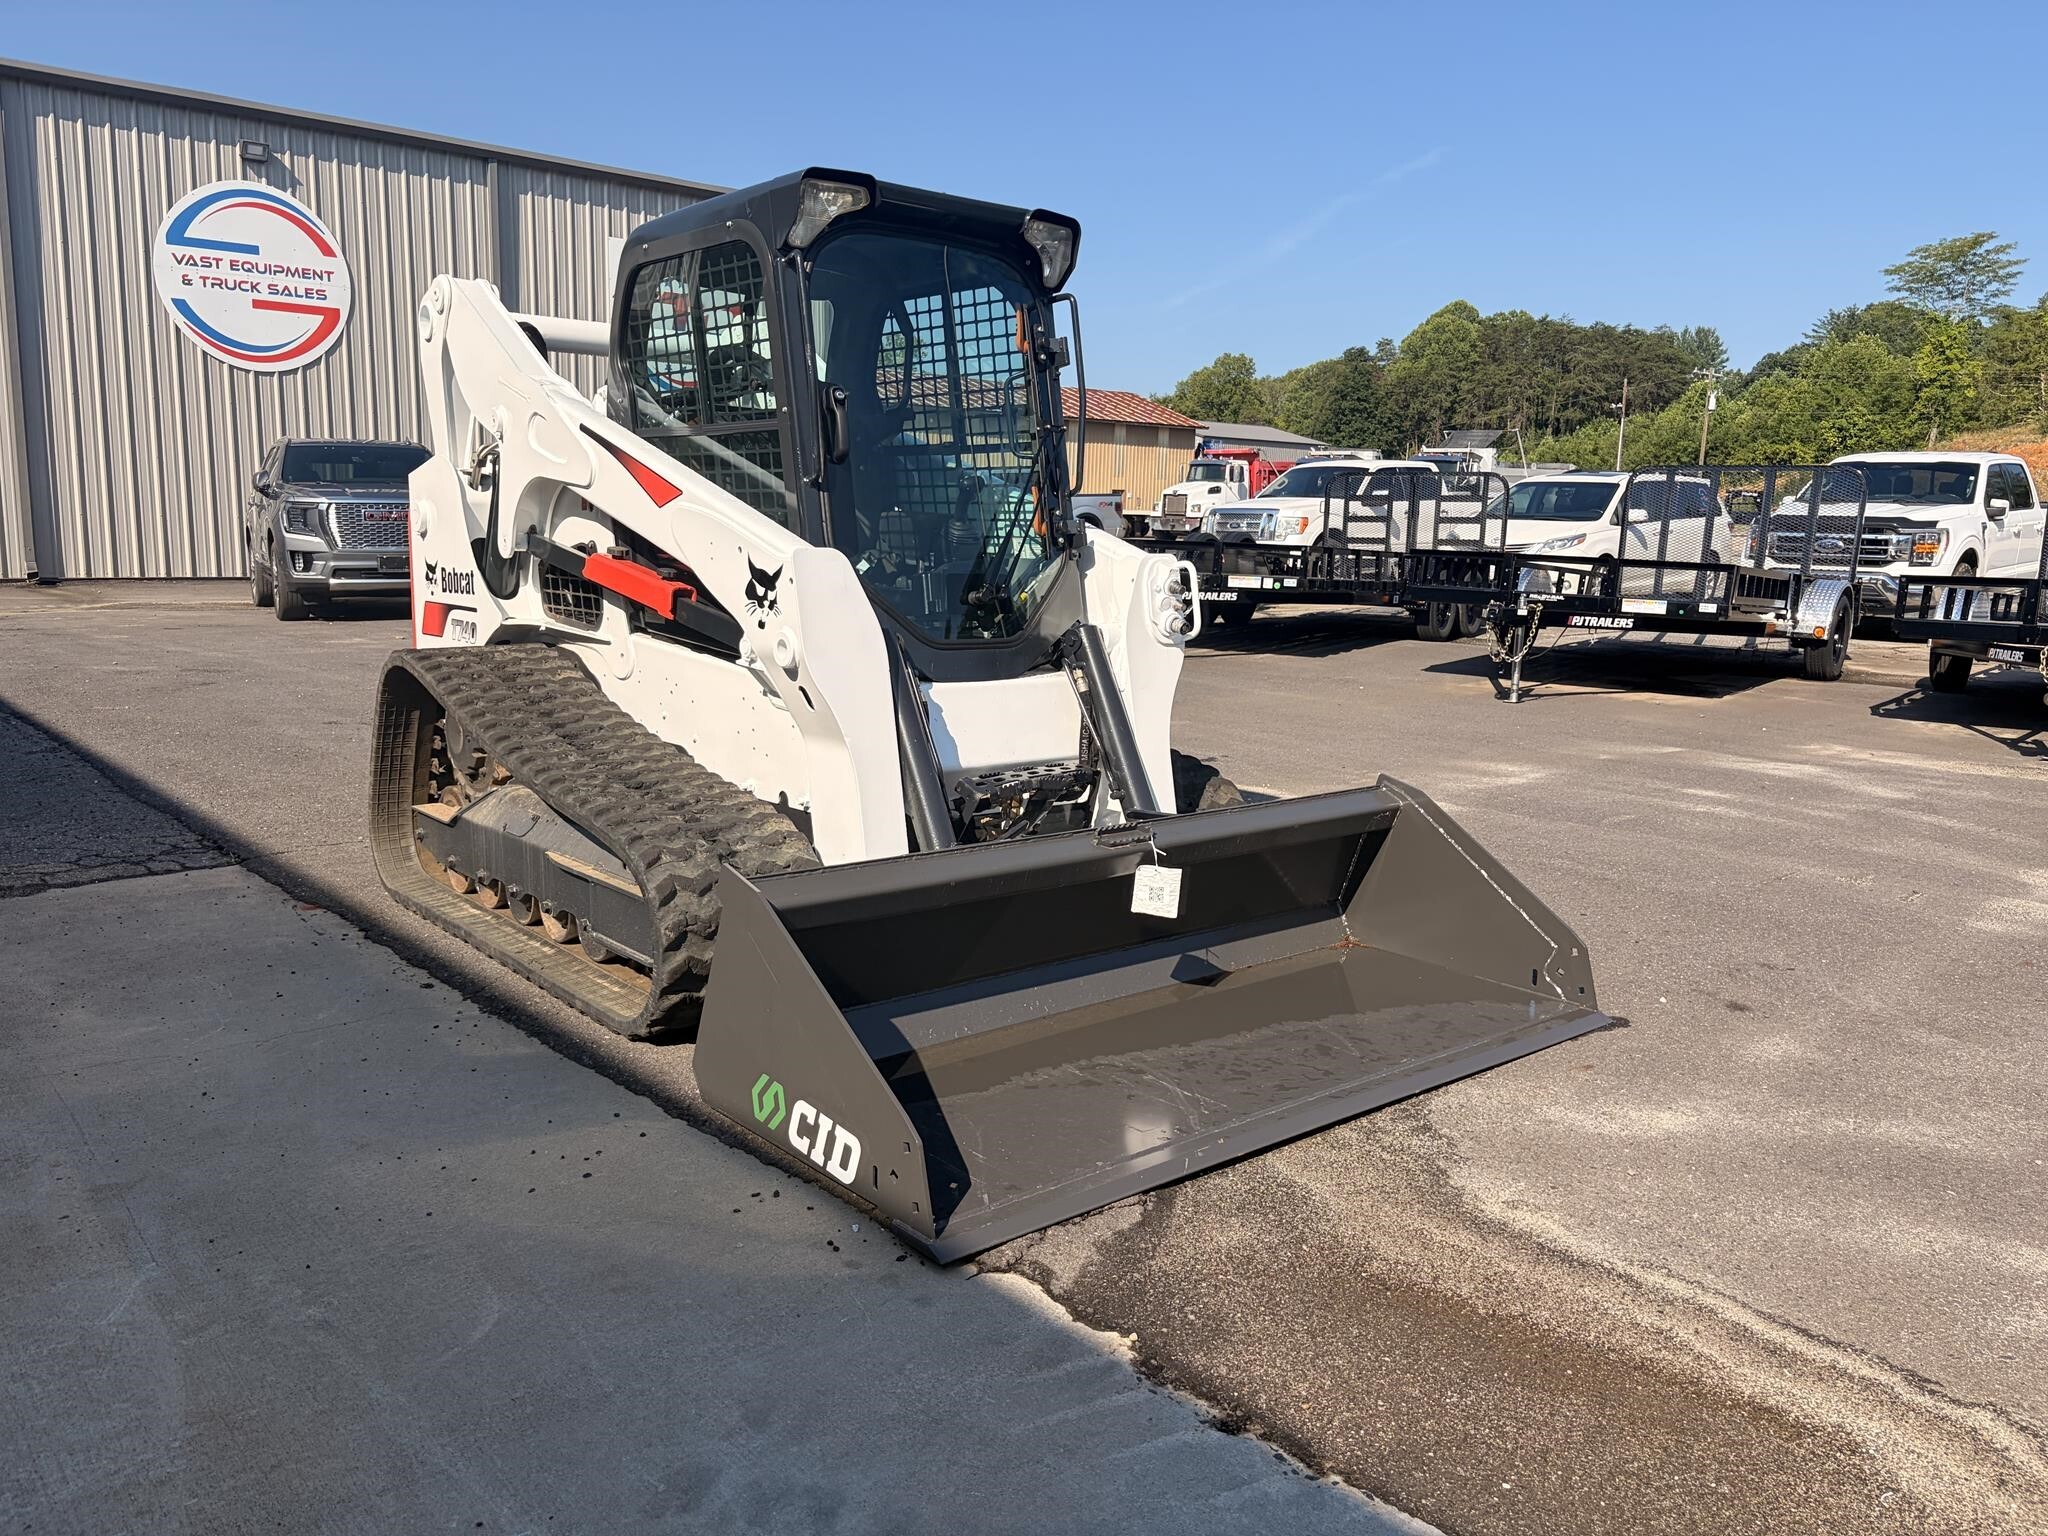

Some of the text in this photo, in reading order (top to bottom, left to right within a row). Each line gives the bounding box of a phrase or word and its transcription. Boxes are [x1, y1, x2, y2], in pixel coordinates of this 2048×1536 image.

[171, 252, 334, 282] VAST EQUIPMENT
[181, 274, 327, 300] & TRUCK SALES
[441, 567, 475, 595] Bobcat
[451, 618, 477, 644] T740
[1081, 739, 1089, 761] MSHA
[788, 1099, 861, 1185] CID
